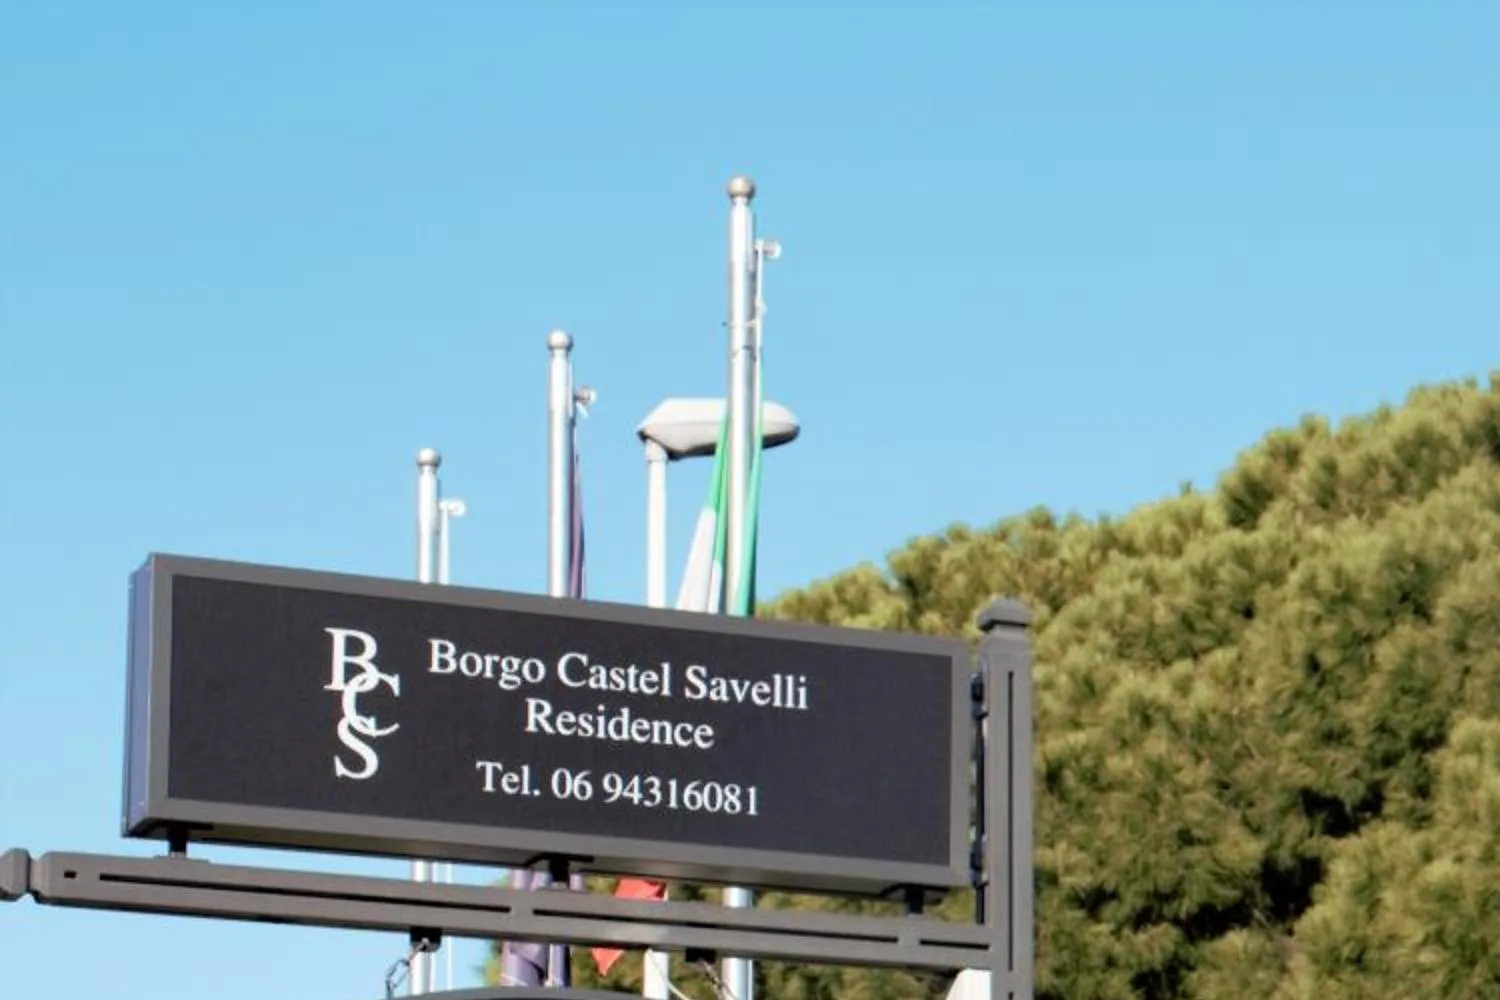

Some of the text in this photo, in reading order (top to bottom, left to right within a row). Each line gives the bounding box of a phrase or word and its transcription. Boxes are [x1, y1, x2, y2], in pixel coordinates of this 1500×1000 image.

[428, 638, 809, 710] Borgo Castel Savelli
[525, 697, 714, 749] Residence
[475, 760, 759, 817] Tel. 06 94316081
